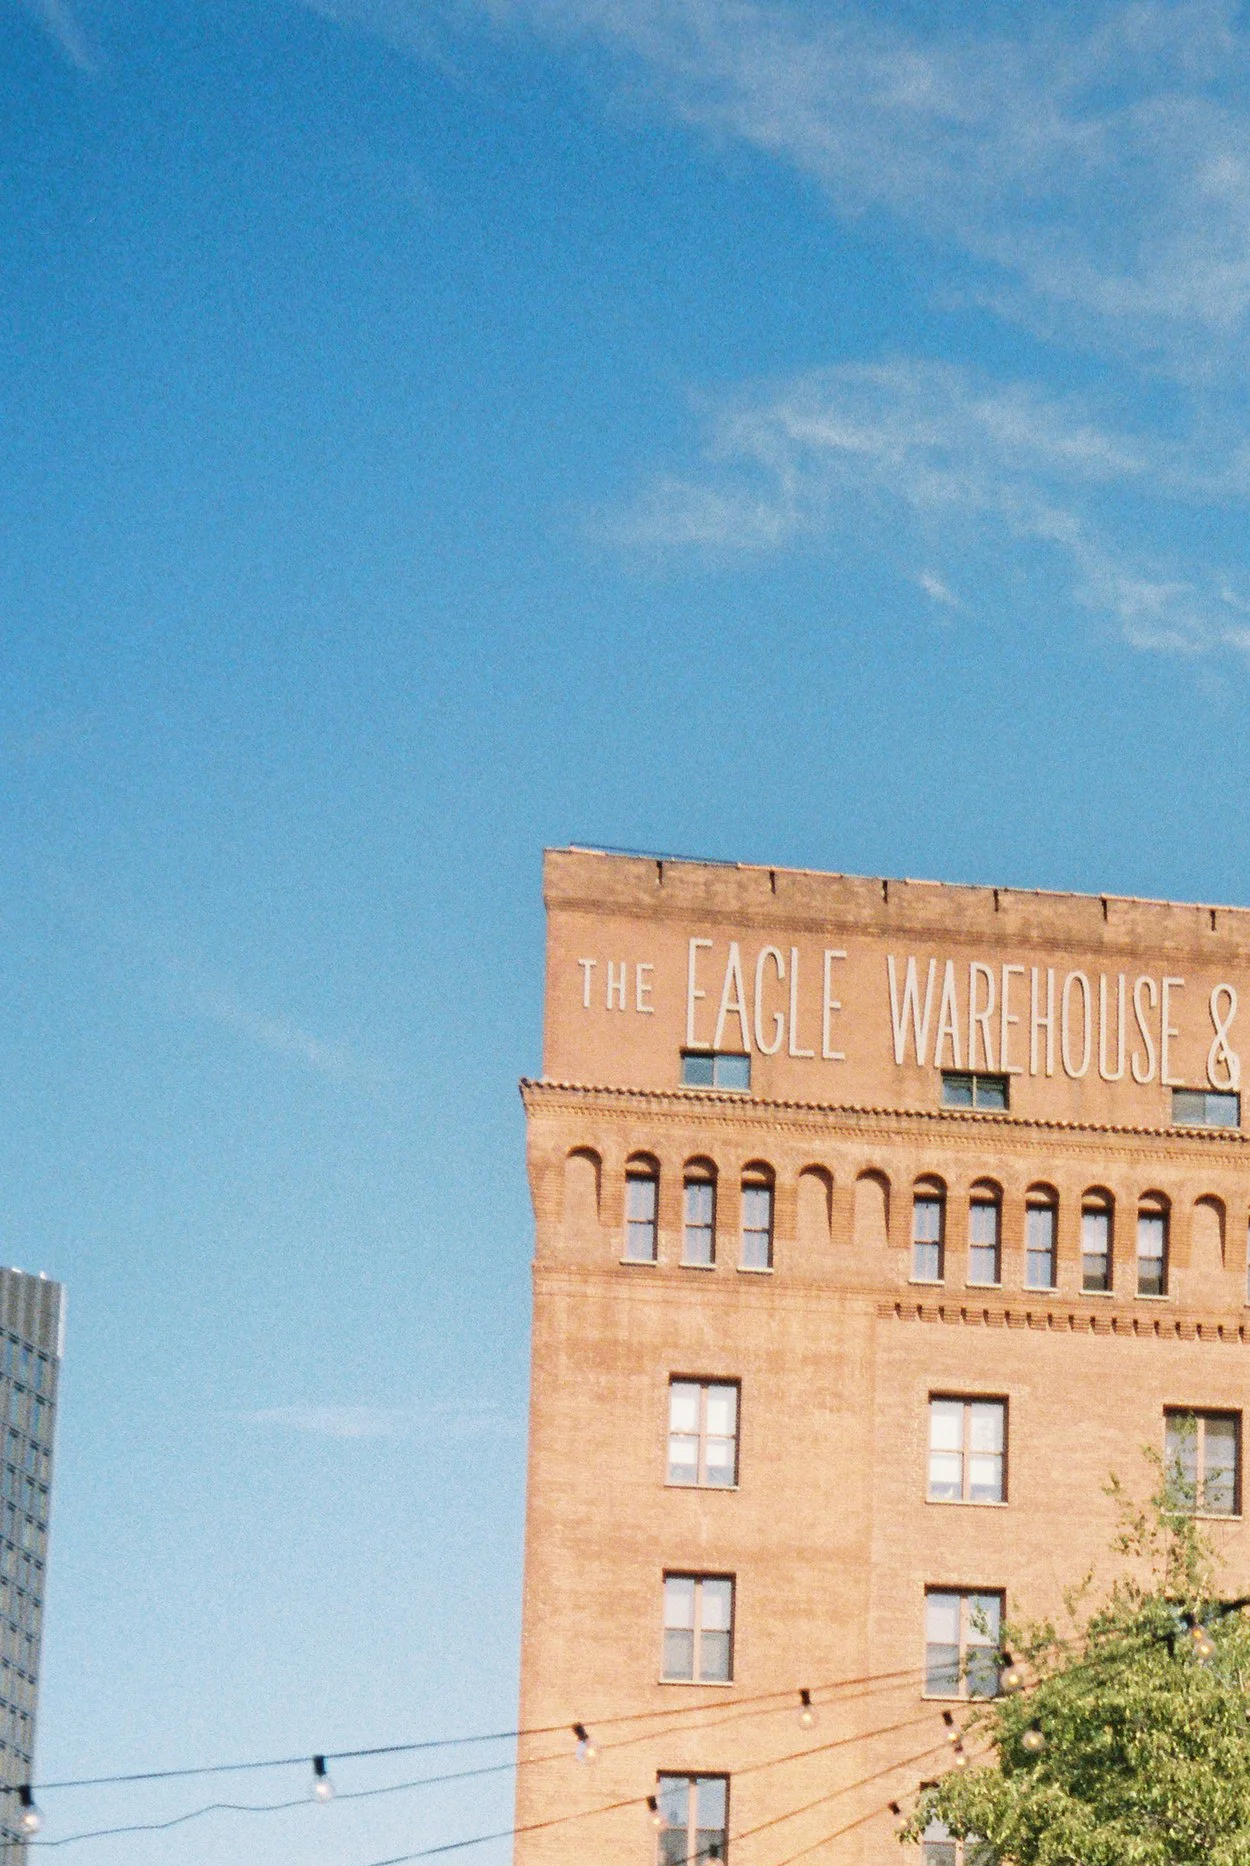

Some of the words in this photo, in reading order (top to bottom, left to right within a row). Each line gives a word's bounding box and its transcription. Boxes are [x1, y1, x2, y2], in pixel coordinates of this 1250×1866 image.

[579, 959, 655, 1013] THE
[687, 938, 847, 1060] EAGLE
[888, 955, 1186, 1086] WAREHOUSE
[1208, 983, 1240, 1091] &
